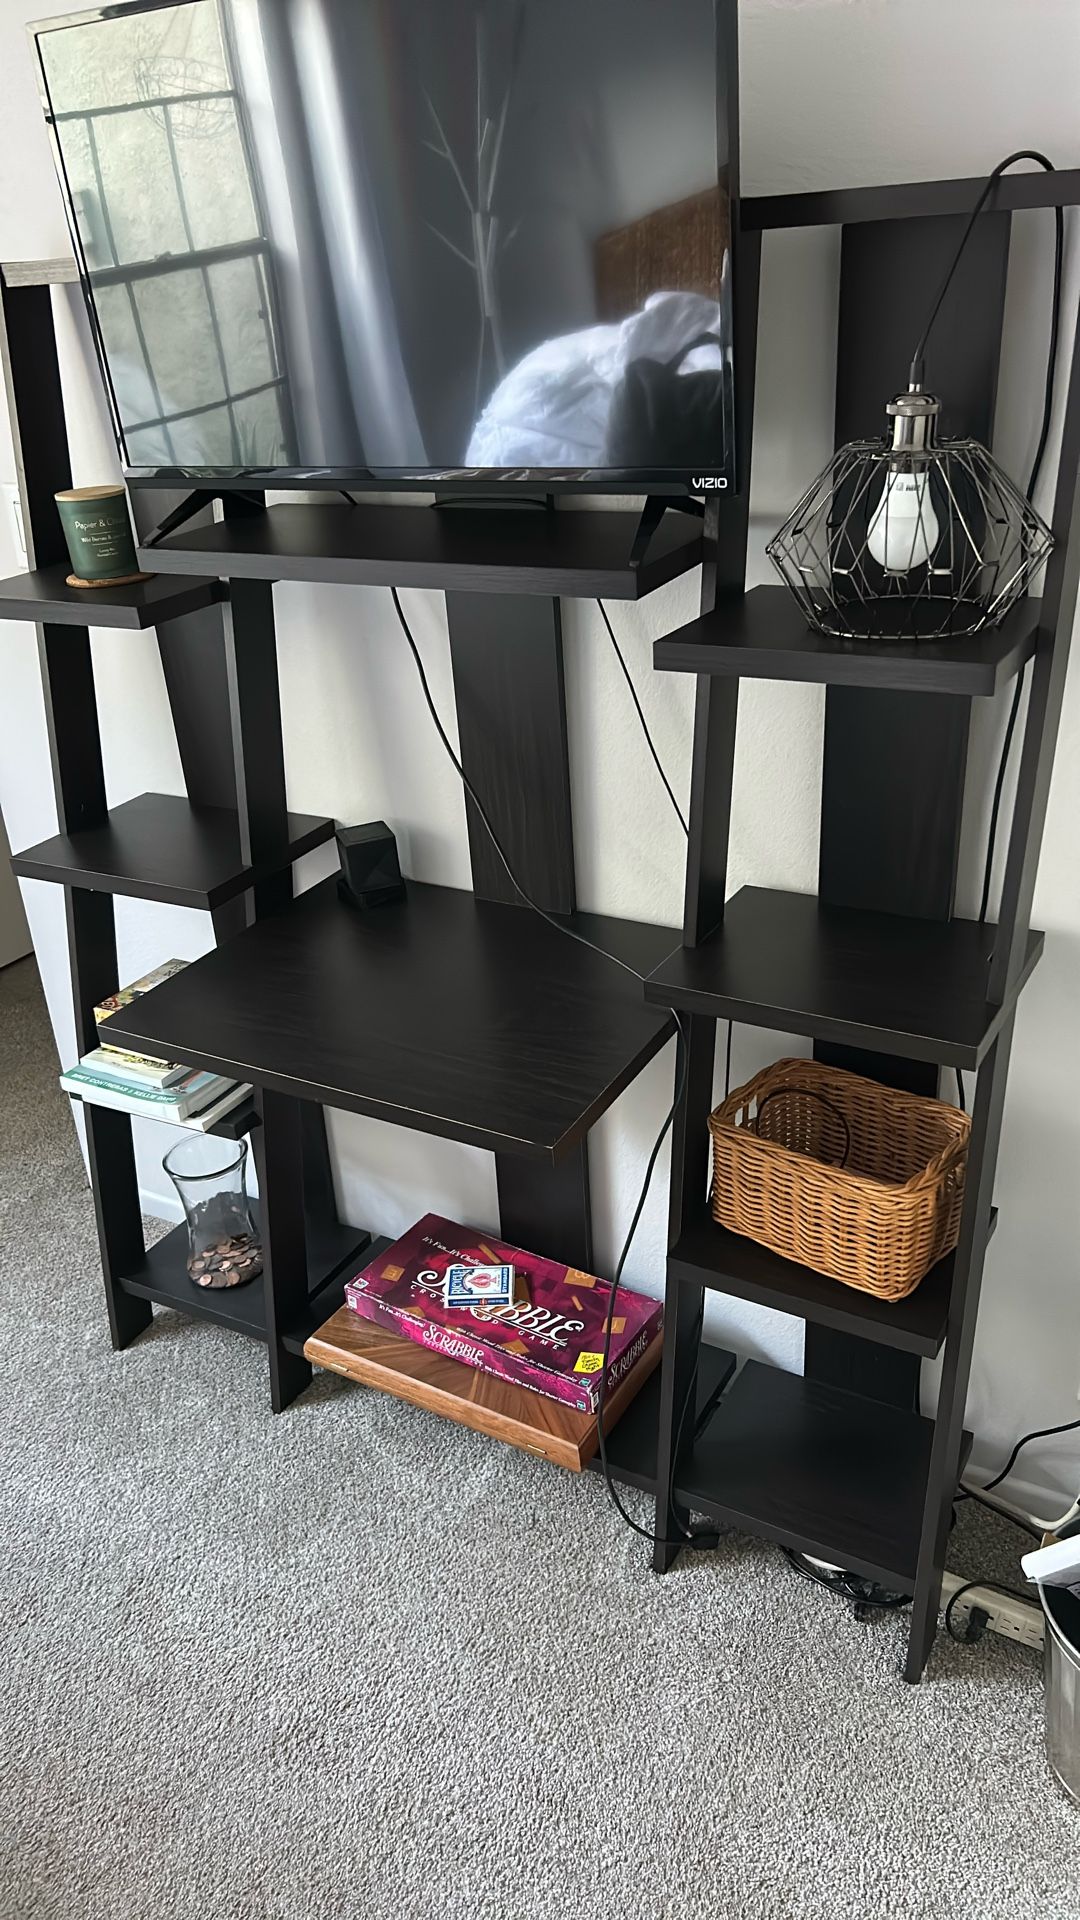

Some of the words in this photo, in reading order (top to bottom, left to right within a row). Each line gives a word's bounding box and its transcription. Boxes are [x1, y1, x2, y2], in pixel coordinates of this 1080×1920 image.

[692, 477, 728, 489] VIZIO
[451, 1269, 469, 1295] BICYCLE
[423, 1324, 485, 1360] SCRABBLE
[518, 1330, 561, 1350] GAME
